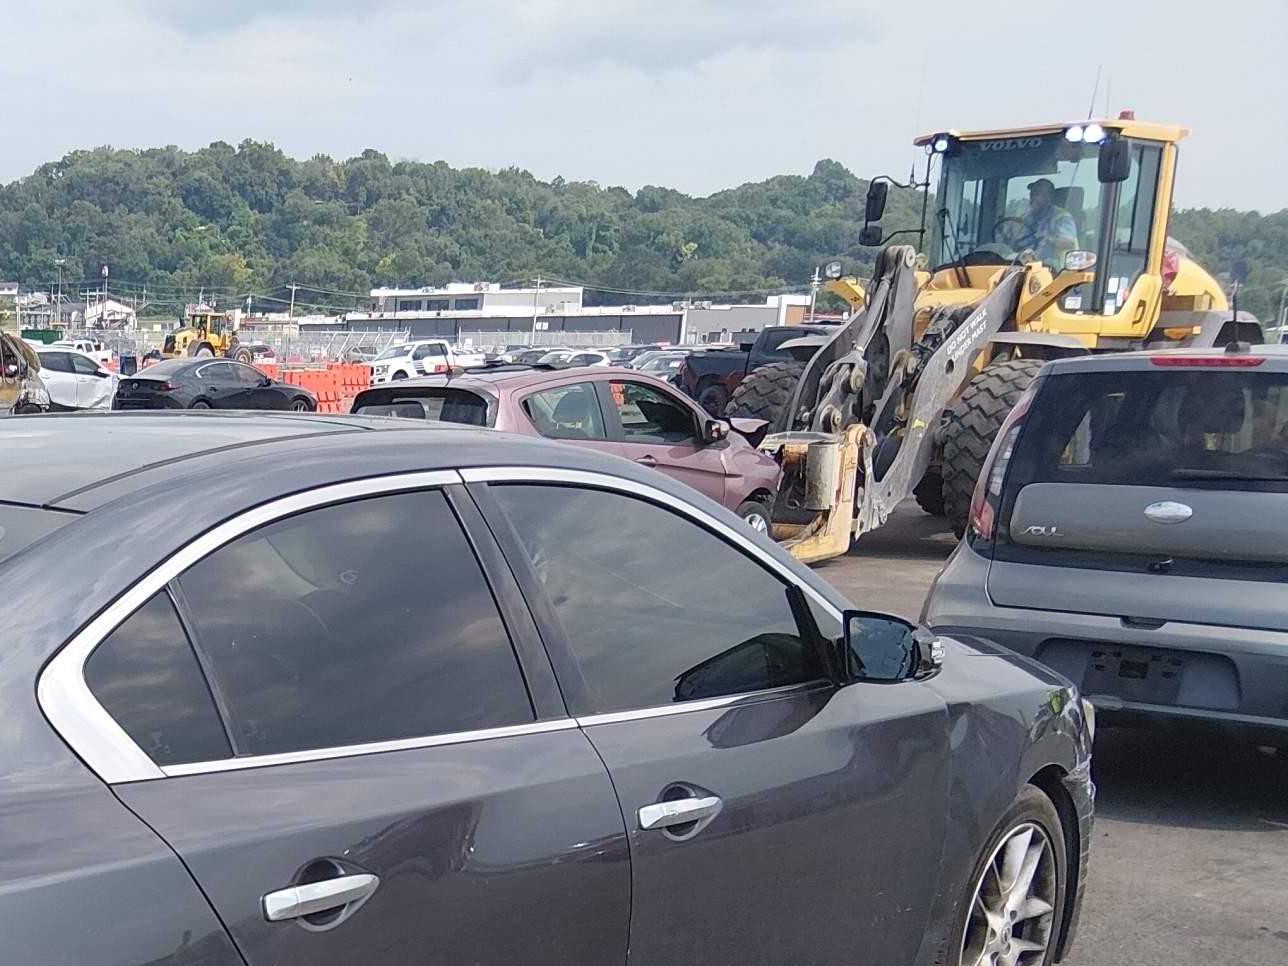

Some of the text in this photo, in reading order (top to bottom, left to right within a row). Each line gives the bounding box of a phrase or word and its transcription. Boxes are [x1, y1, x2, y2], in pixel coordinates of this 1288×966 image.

[980, 138, 1043, 152] VOLVO
[946, 308, 987, 355] DO NOT WALK
[971, 320, 987, 341] MAST
[1020, 526, 1064, 537] SOUL
